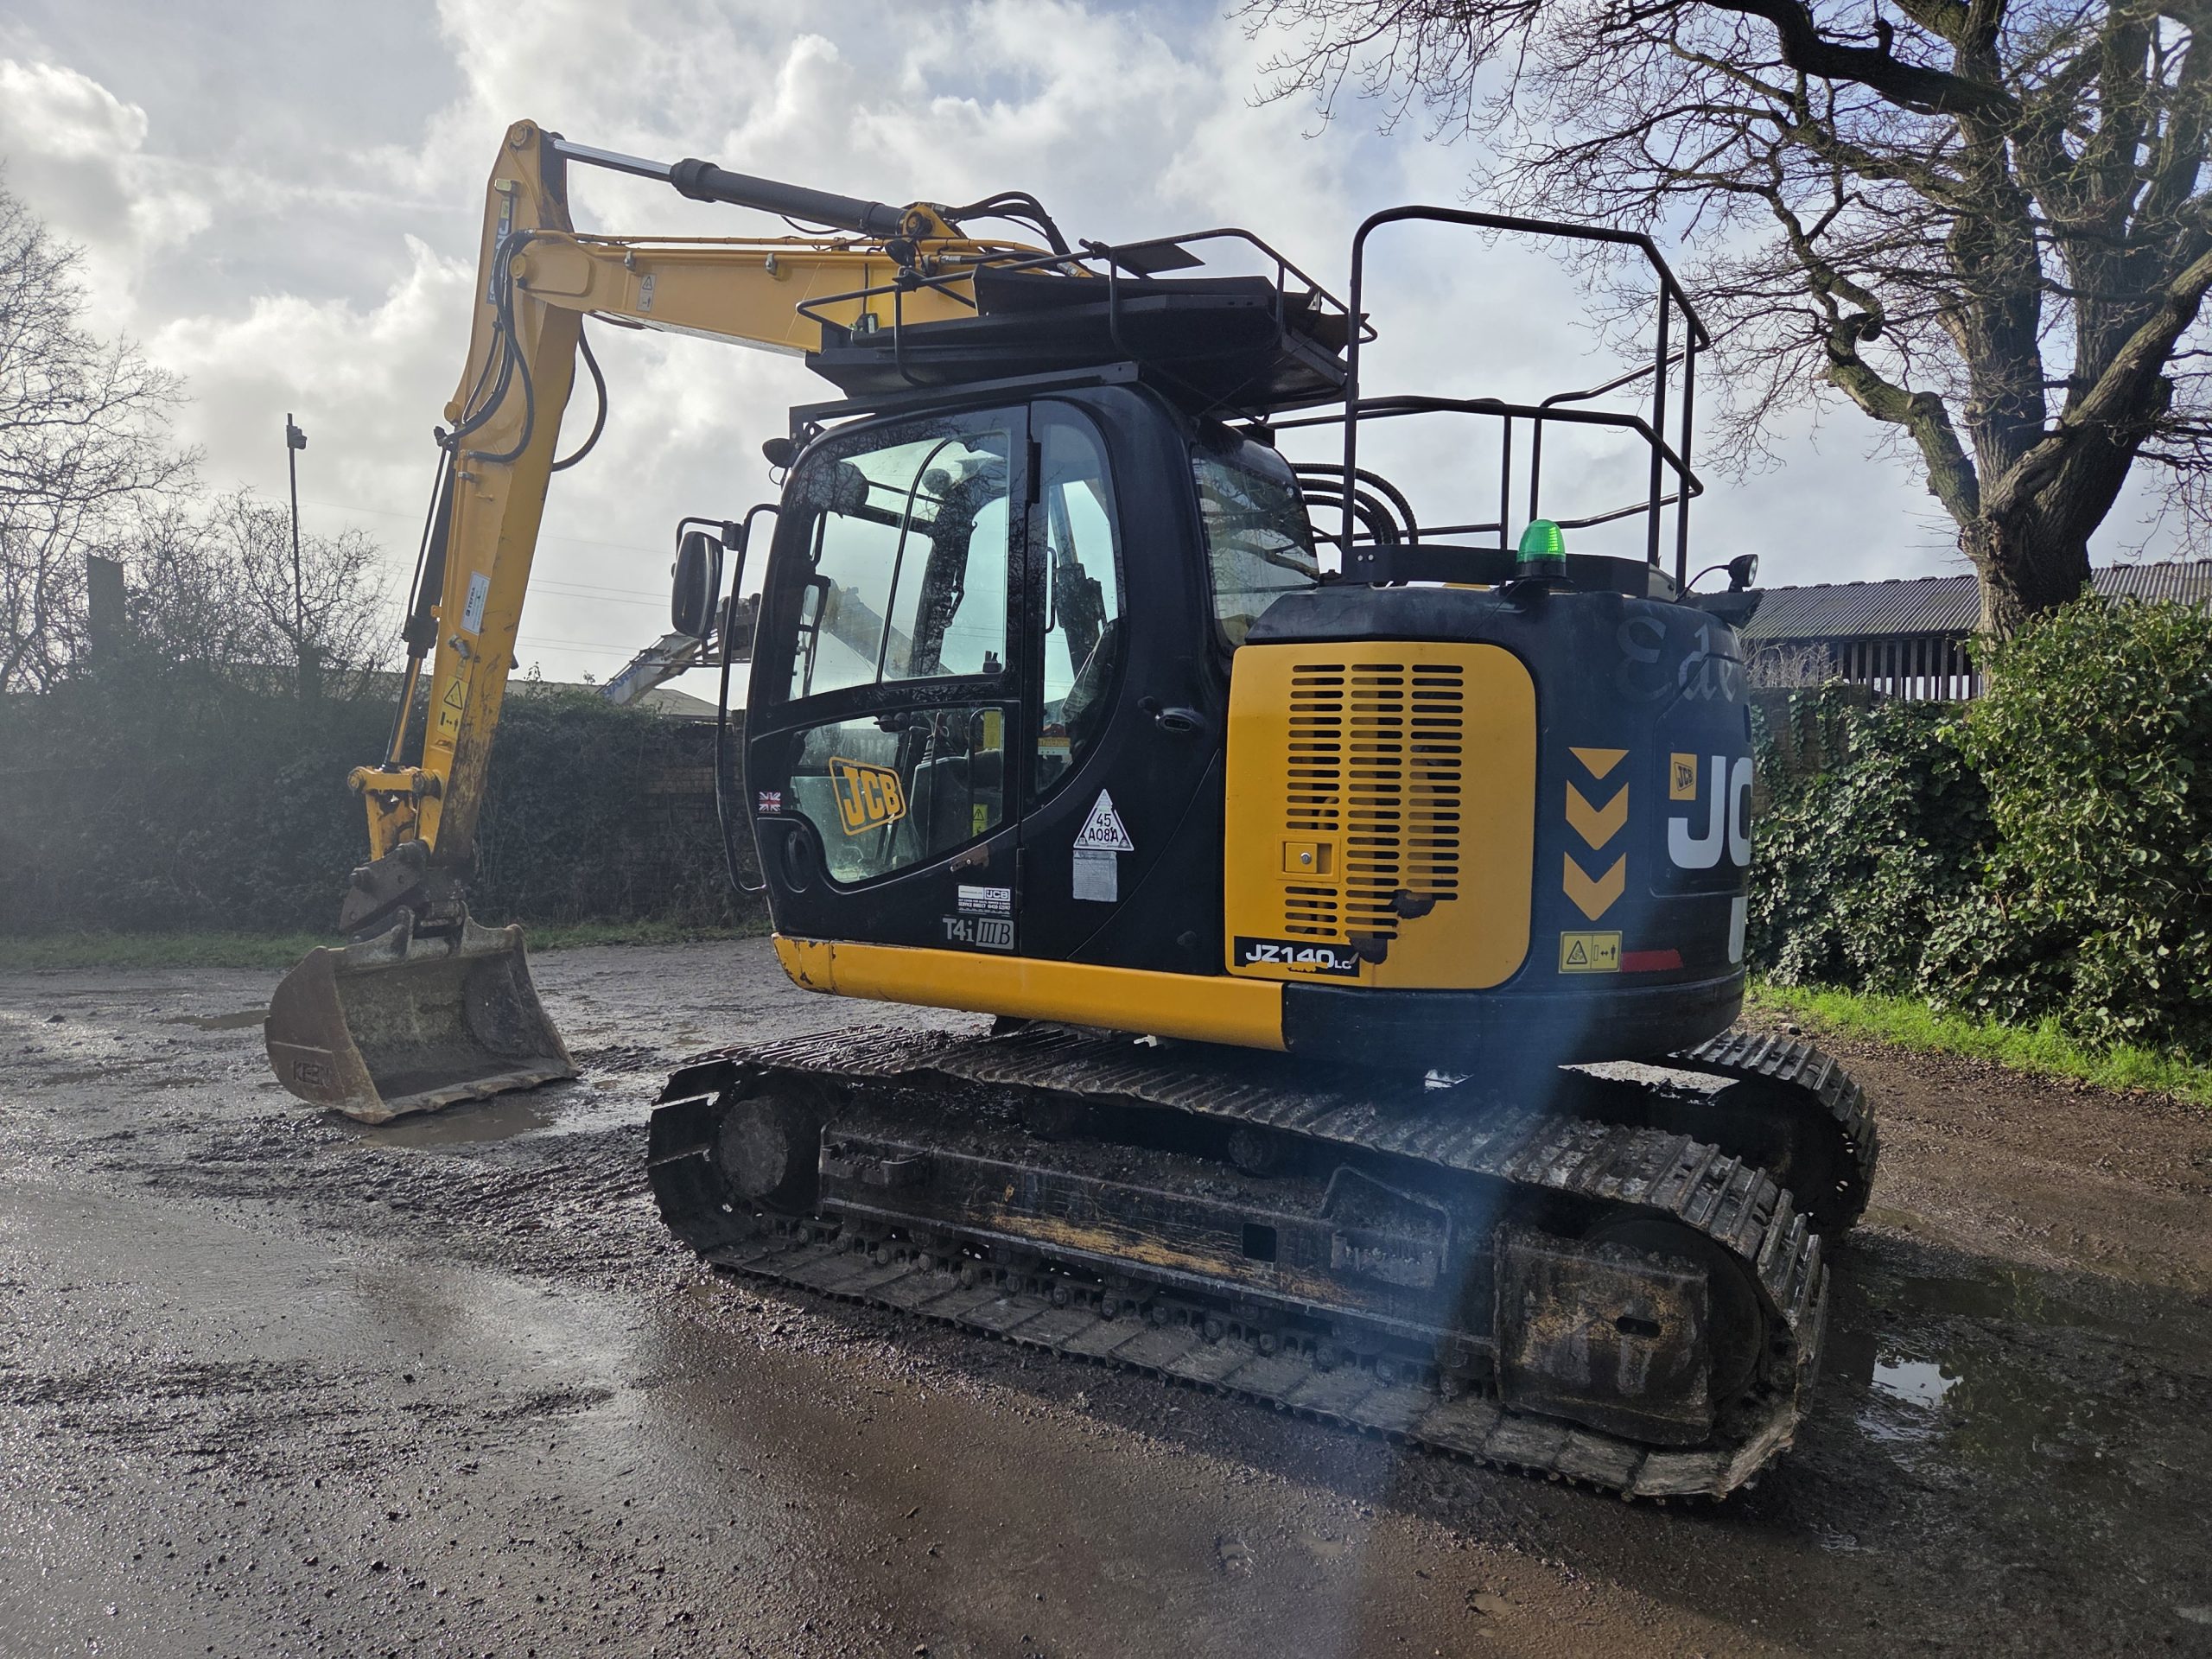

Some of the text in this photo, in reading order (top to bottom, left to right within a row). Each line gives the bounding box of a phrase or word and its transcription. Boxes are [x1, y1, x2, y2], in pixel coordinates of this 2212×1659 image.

[1677, 764, 1694, 790] JCB
[842, 766, 900, 827] JCB
[1096, 813, 1112, 828] 45
[986, 890, 1008, 899] JCB
[942, 918, 975, 943] T4i
